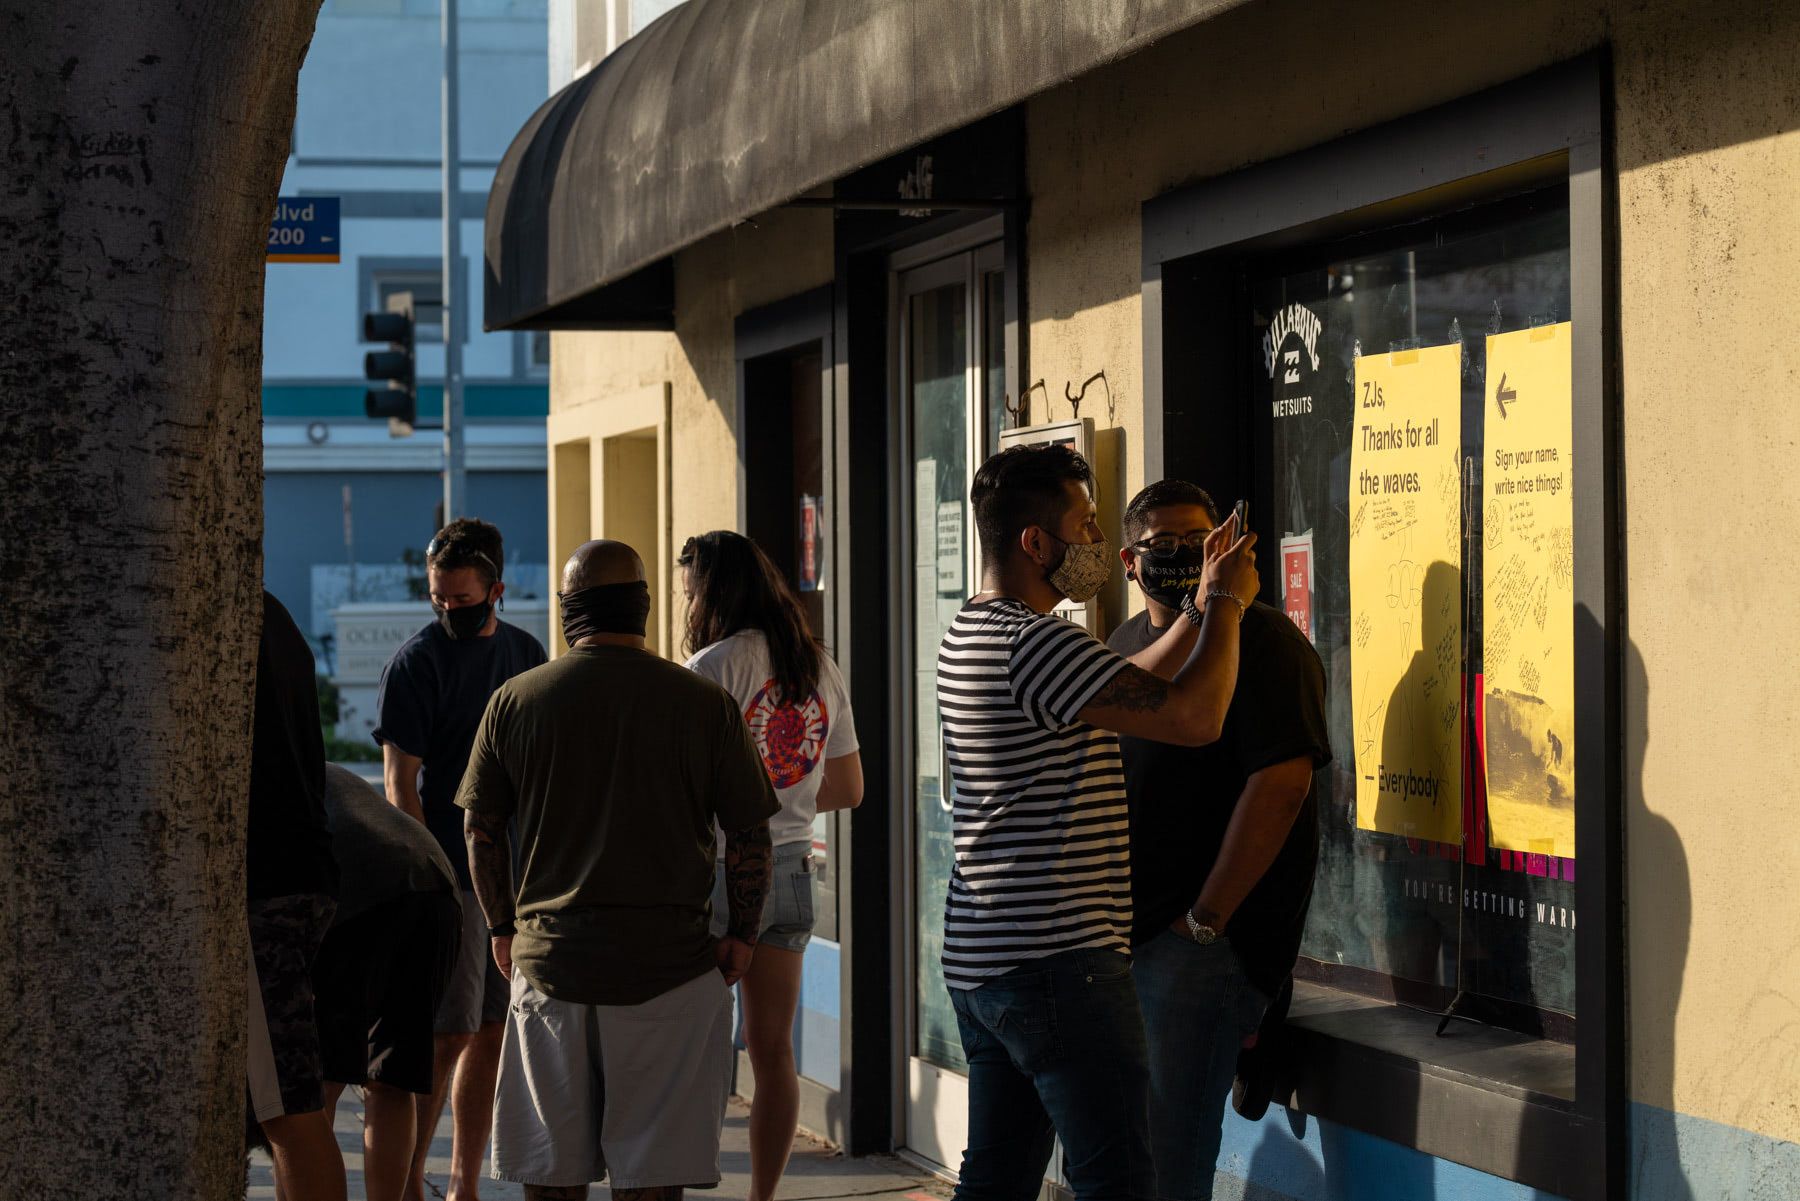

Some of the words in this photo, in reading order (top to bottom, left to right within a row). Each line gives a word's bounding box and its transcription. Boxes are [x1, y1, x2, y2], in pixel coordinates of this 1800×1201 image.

[1262, 300, 1322, 379] BILLABONG
[1272, 395, 1312, 418] WETSUITS
[1363, 381, 1385, 411] ZJs,
[1362, 422, 1403, 451] Thanks
[1405, 419, 1422, 448] for
[1425, 418, 1438, 446] all
[1495, 449, 1513, 471] Sign
[1515, 450, 1533, 469] your
[1535, 447, 1559, 464] name,
[1359, 469, 1380, 495] the
[1383, 472, 1421, 494] waves.
[1494, 477, 1515, 495] write
[1517, 475, 1533, 493] nice
[1536, 472, 1563, 496] things!
[1149, 566, 1176, 575] BORN
[1188, 565, 1202, 575] RA
[1290, 573, 1303, 588] SALE
[1378, 764, 1439, 806] Everybody
[1404, 878, 1453, 905] YOU'RE
[1463, 888, 1525, 919] GETTING
